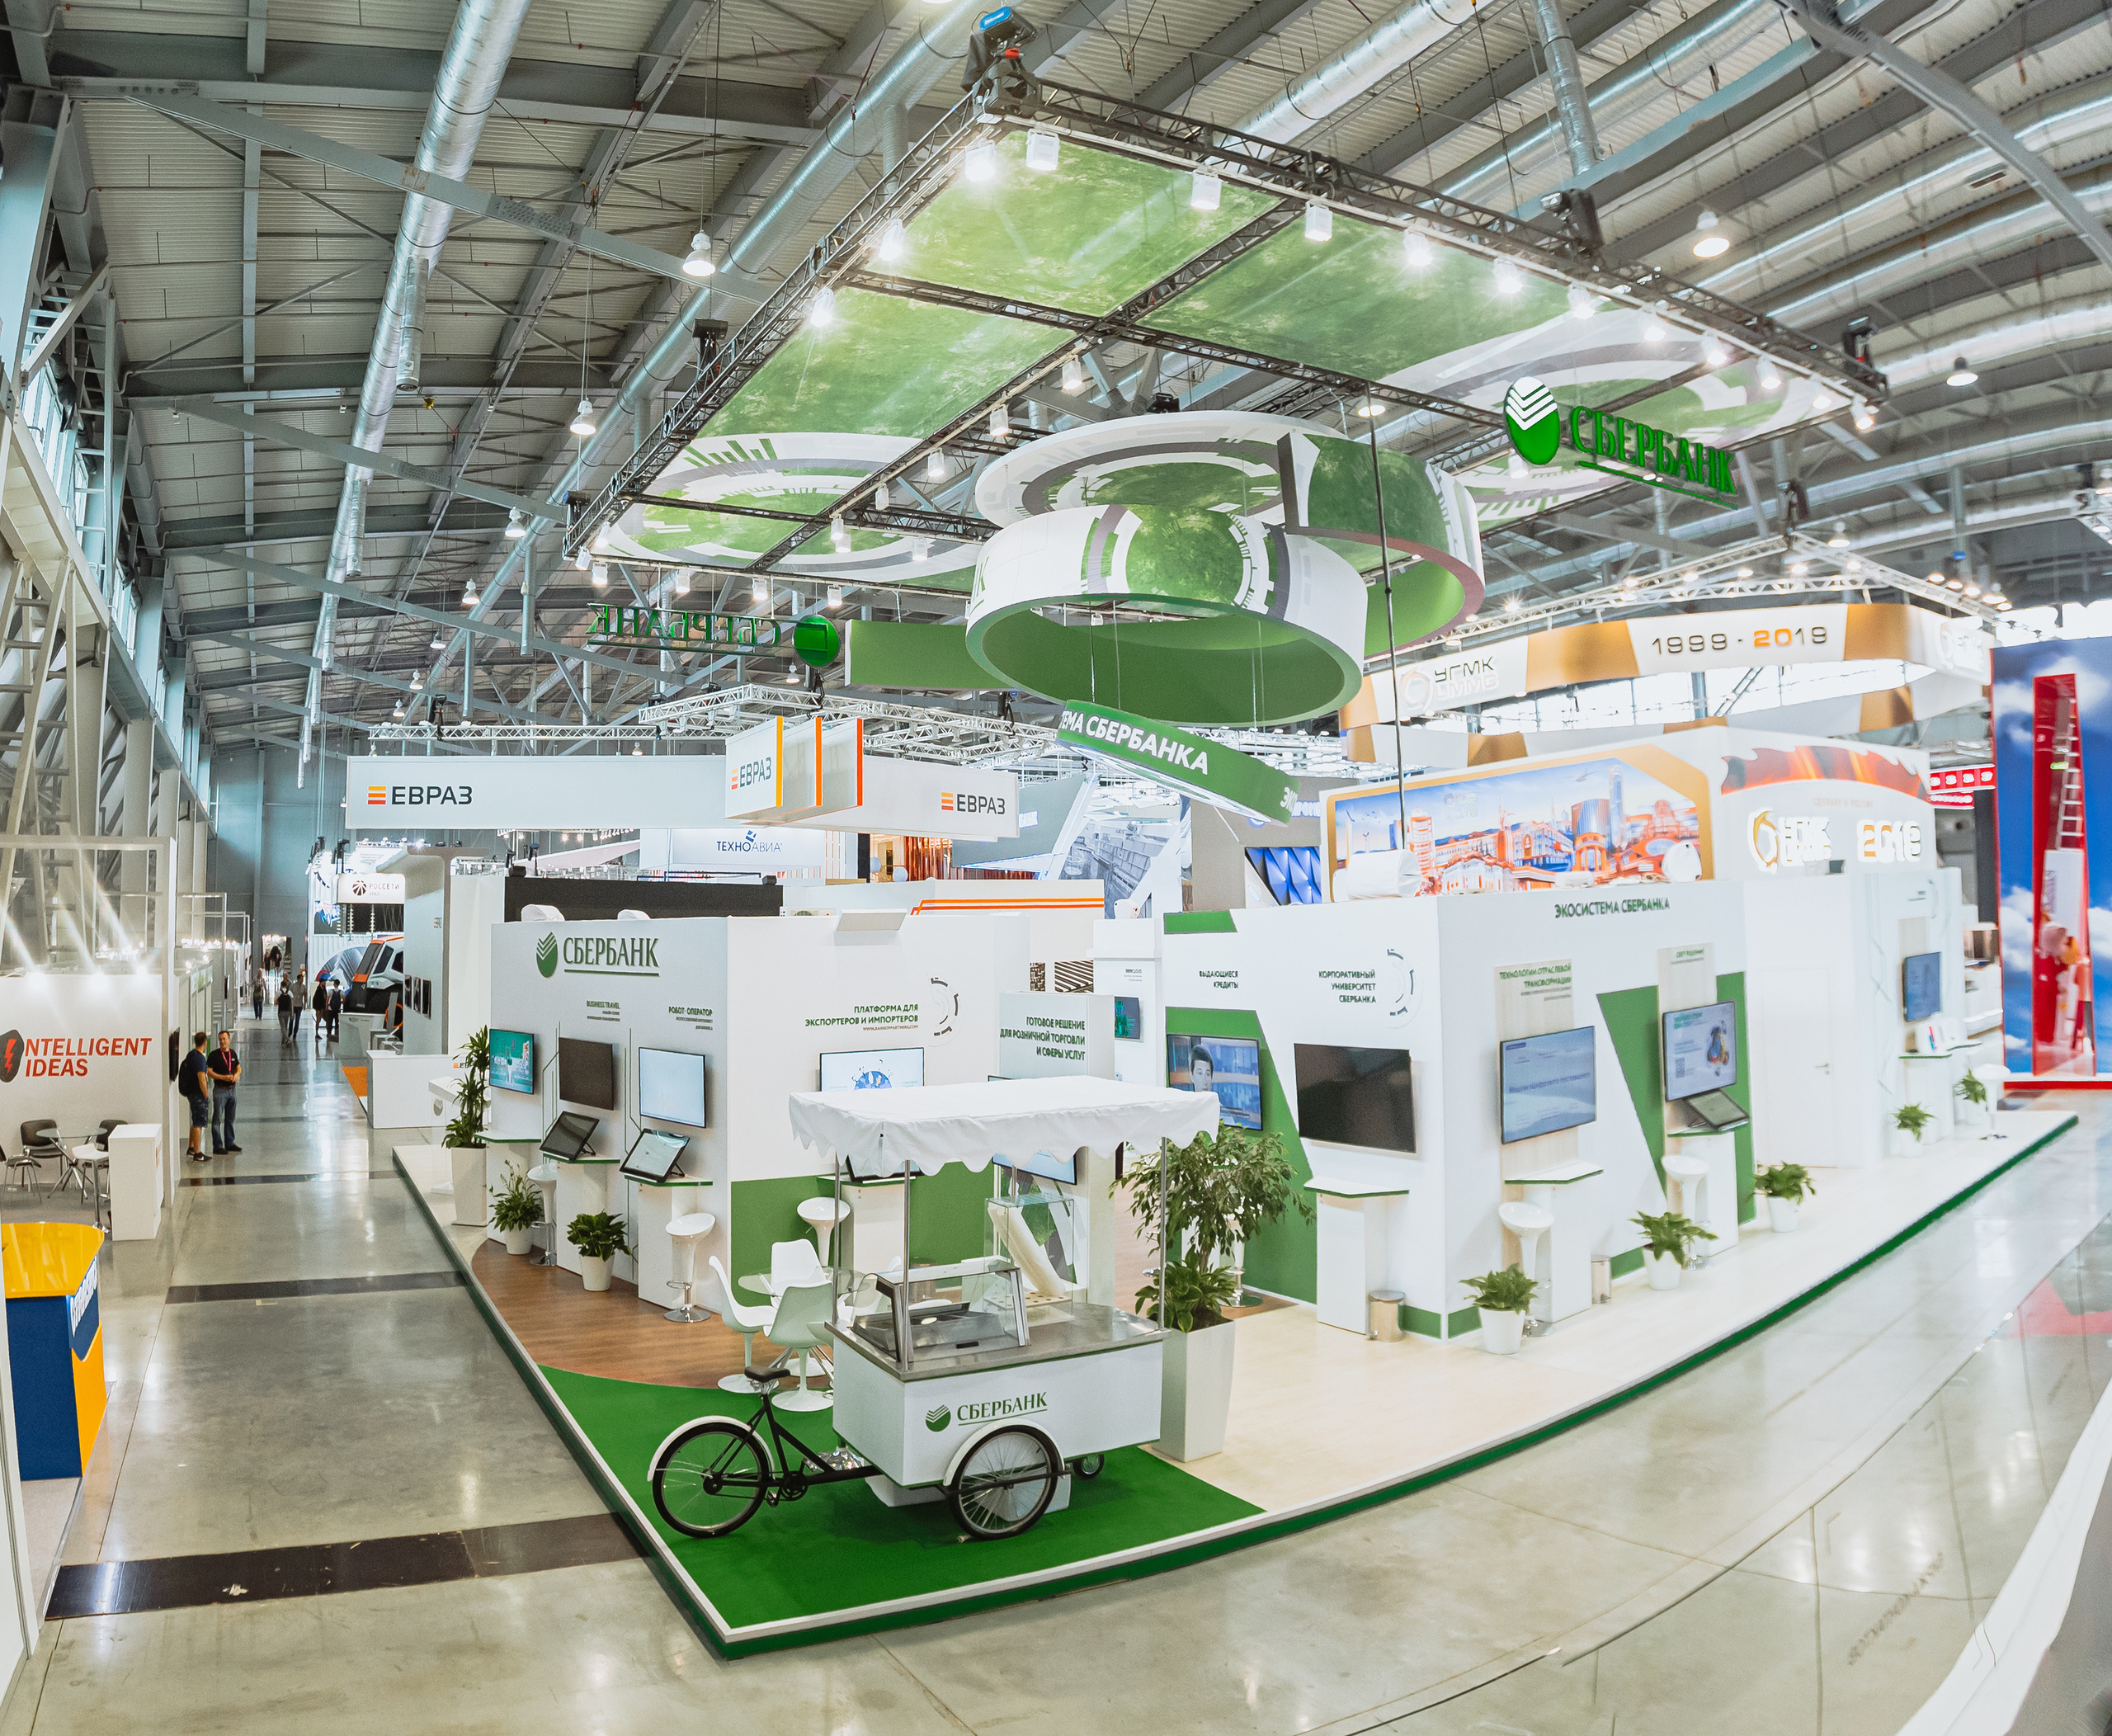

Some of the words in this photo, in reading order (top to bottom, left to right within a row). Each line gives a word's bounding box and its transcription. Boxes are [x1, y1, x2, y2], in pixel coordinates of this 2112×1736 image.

[1570, 405, 1737, 494] СБЕРБАНК
[1652, 633, 1728, 655] 1999
[1754, 626, 1827, 647] 2019
[1435, 656, 1494, 682] УГМК
[1086, 715, 1209, 776] СБЕРБАНКА
[739, 757, 771, 788] ЕВРАЗ
[391, 785, 474, 805] ЕВРАЗ
[956, 793, 1006, 815] ЕВРАЗ
[369, 882, 399, 890] РОССЕТИ
[1554, 901, 1619, 918] ЭКОСИСТЕМА
[1621, 897, 1671, 913] СБЕРБАНКА
[563, 936, 660, 968] СБЕРБАНК
[1318, 969, 1376, 979] КОРПОРАТИВНЫЙ
[1499, 968, 1537, 979] ТЕХНОЛОГИИ
[1331, 983, 1376, 991] УНИВЕРСИТЕТ
[587, 1000, 604, 1008] BUSINESS
[854, 1005, 902, 1013] ПЛАТФОРМА
[903, 1003, 918, 1012] ДЛЯ
[1339, 995, 1376, 1003] СБЕРБАНКА
[805, 1017, 859, 1026] ЭКСПОРТЕРОВ
[868, 1015, 918, 1024] ИМПОРТЕРОВ
[1026, 1017, 1054, 1027] ГОТОВОЕ
[1054, 1019, 1085, 1030] РЕШЕНИЕ
[1000, 1028, 1011, 1038] ДЛЯ
[1012, 1029, 1050, 1041] РОЗНИЧНОЙ
[1051, 1033, 1086, 1045] ТОРГОВЛИ
[1036, 1046, 1041, 1055] И
[1042, 1046, 1063, 1058] СФЕРЫ
[1064, 1050, 1086, 1060] УСЛУГ
[26, 1058, 89, 1078] IDEAS
[957, 1391, 1048, 1421] СБЕРБАНК
